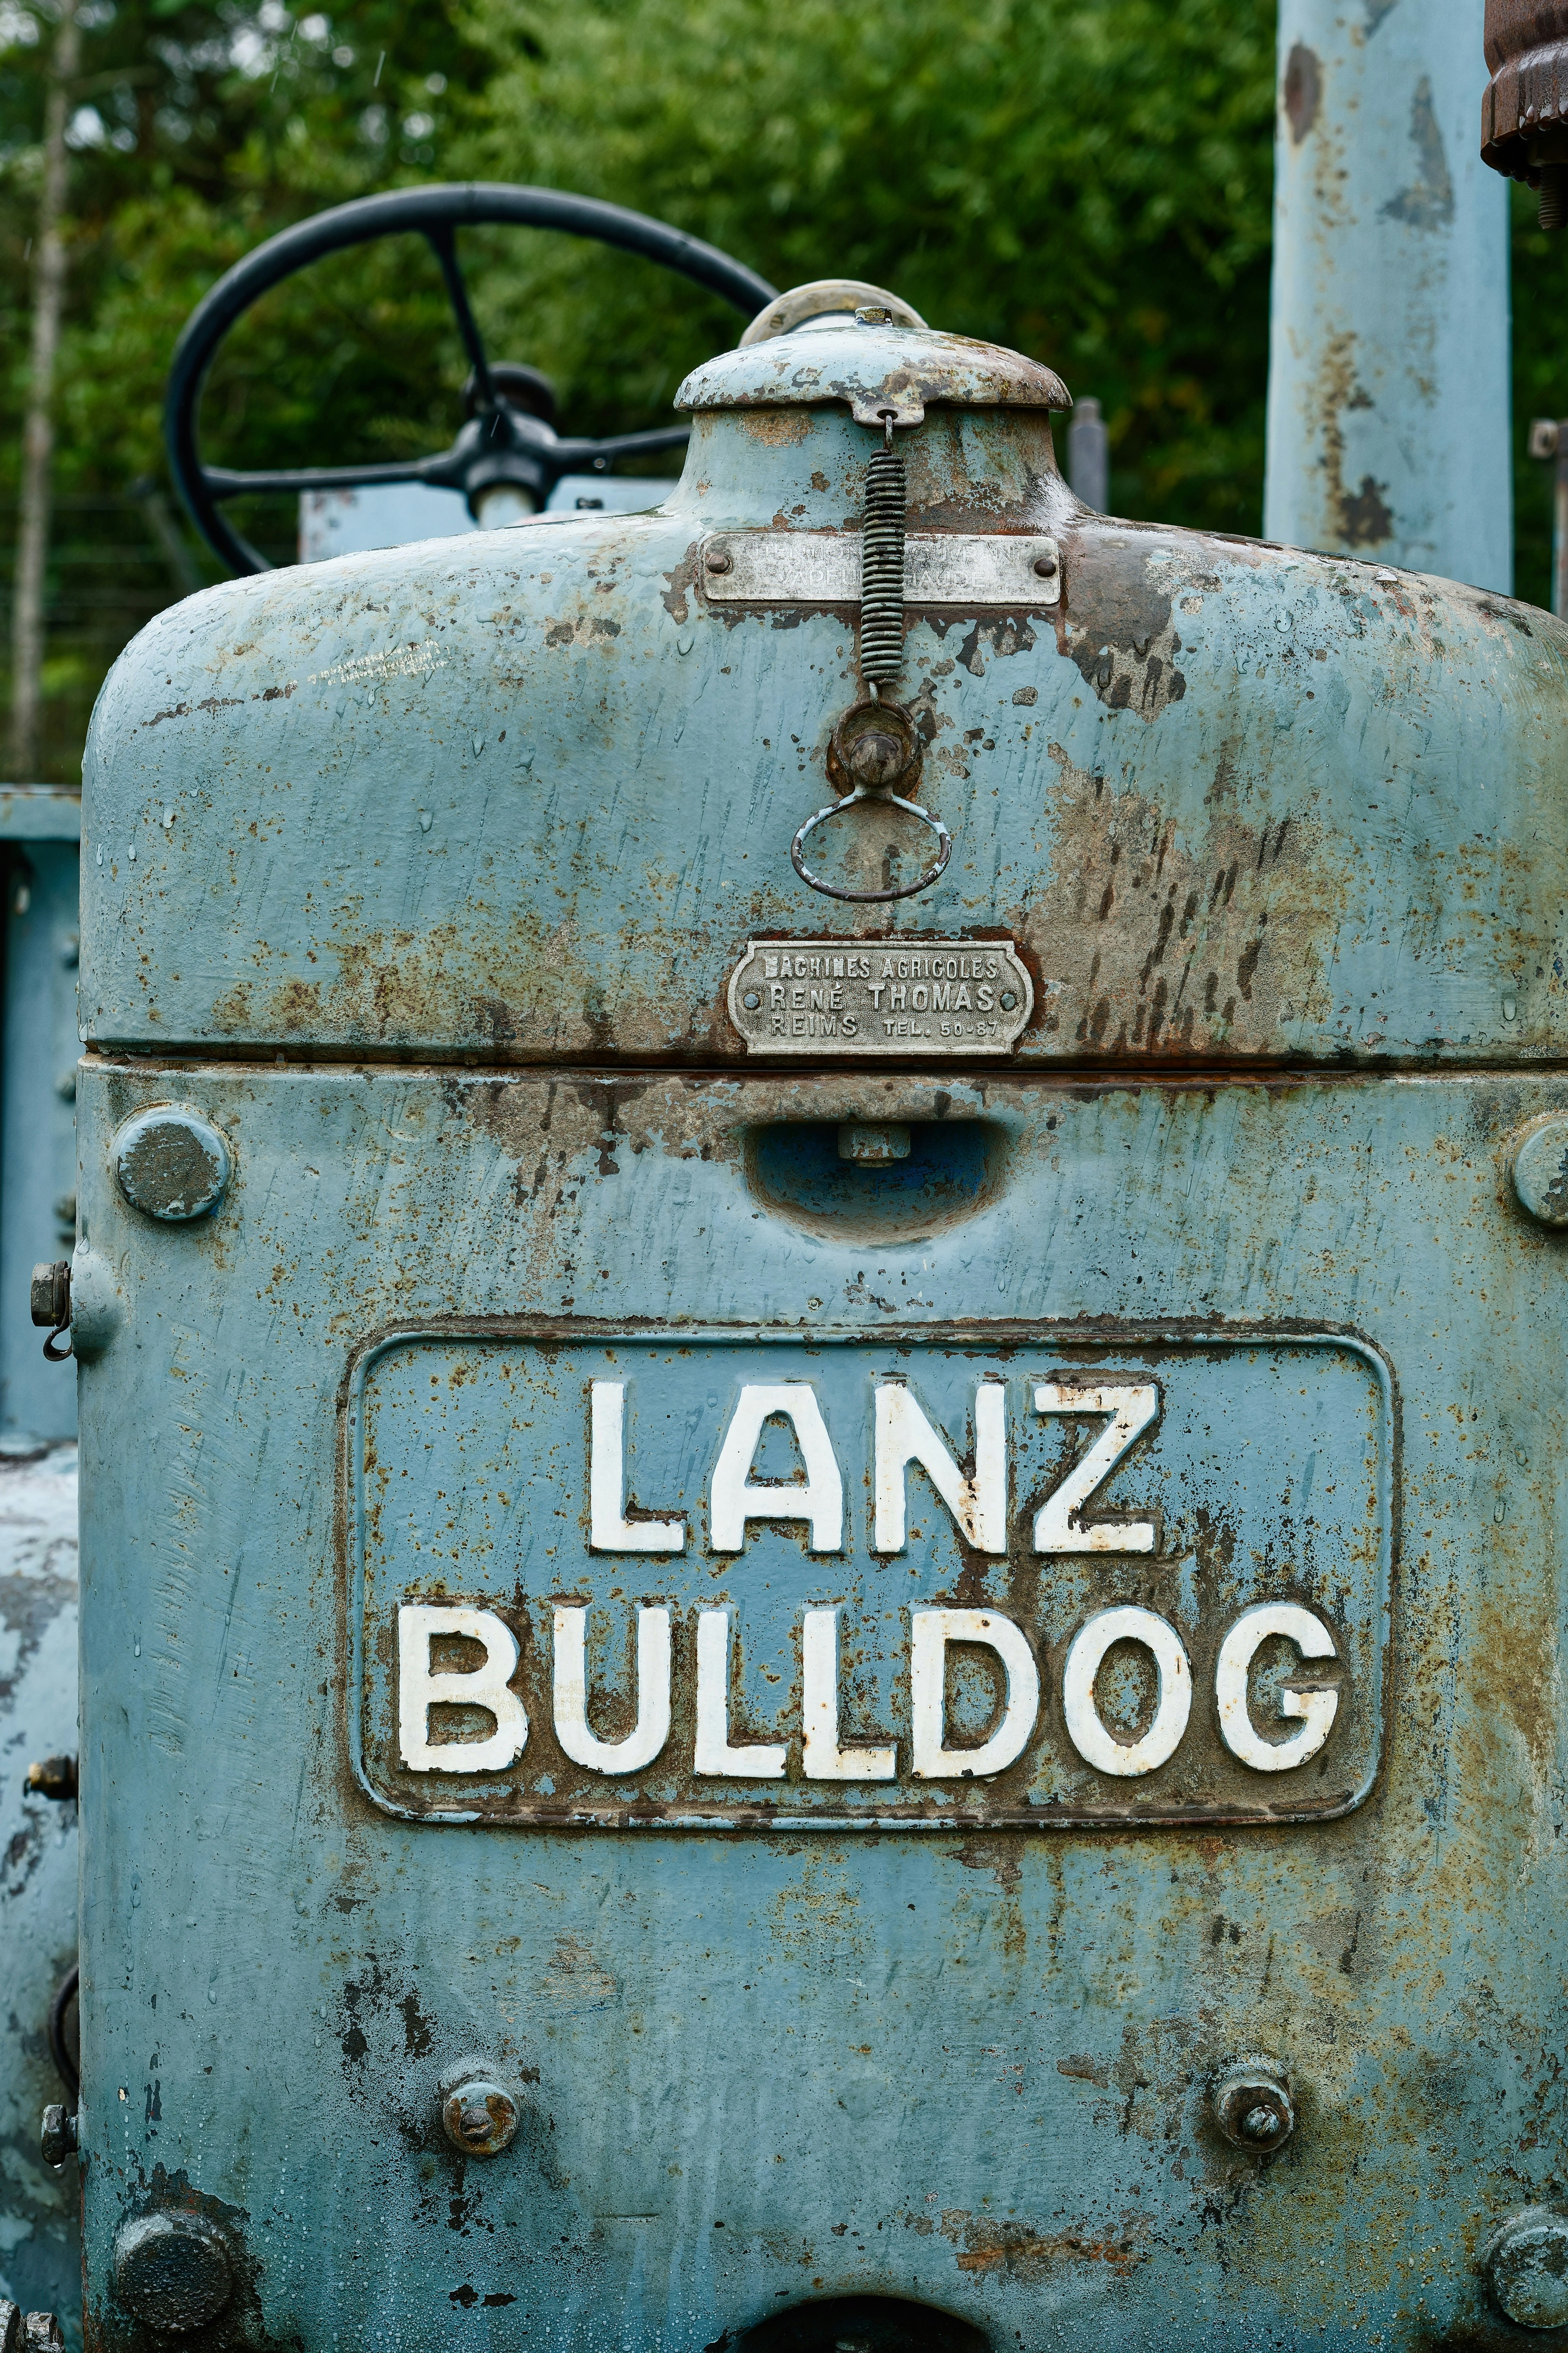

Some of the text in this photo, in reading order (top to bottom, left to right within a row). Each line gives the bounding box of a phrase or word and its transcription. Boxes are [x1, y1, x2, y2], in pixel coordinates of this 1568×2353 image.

[777, 569, 986, 588] VAPEU HAUDE
[881, 957, 998, 980] AGRICOLES
[770, 981, 995, 1012] RENÉ THOMAS
[771, 1015, 858, 1037] REIMS
[883, 1020, 931, 1037] TEL.
[589, 1379, 1160, 1555] LANZ
[397, 1603, 1340, 1782] BULLDOG
